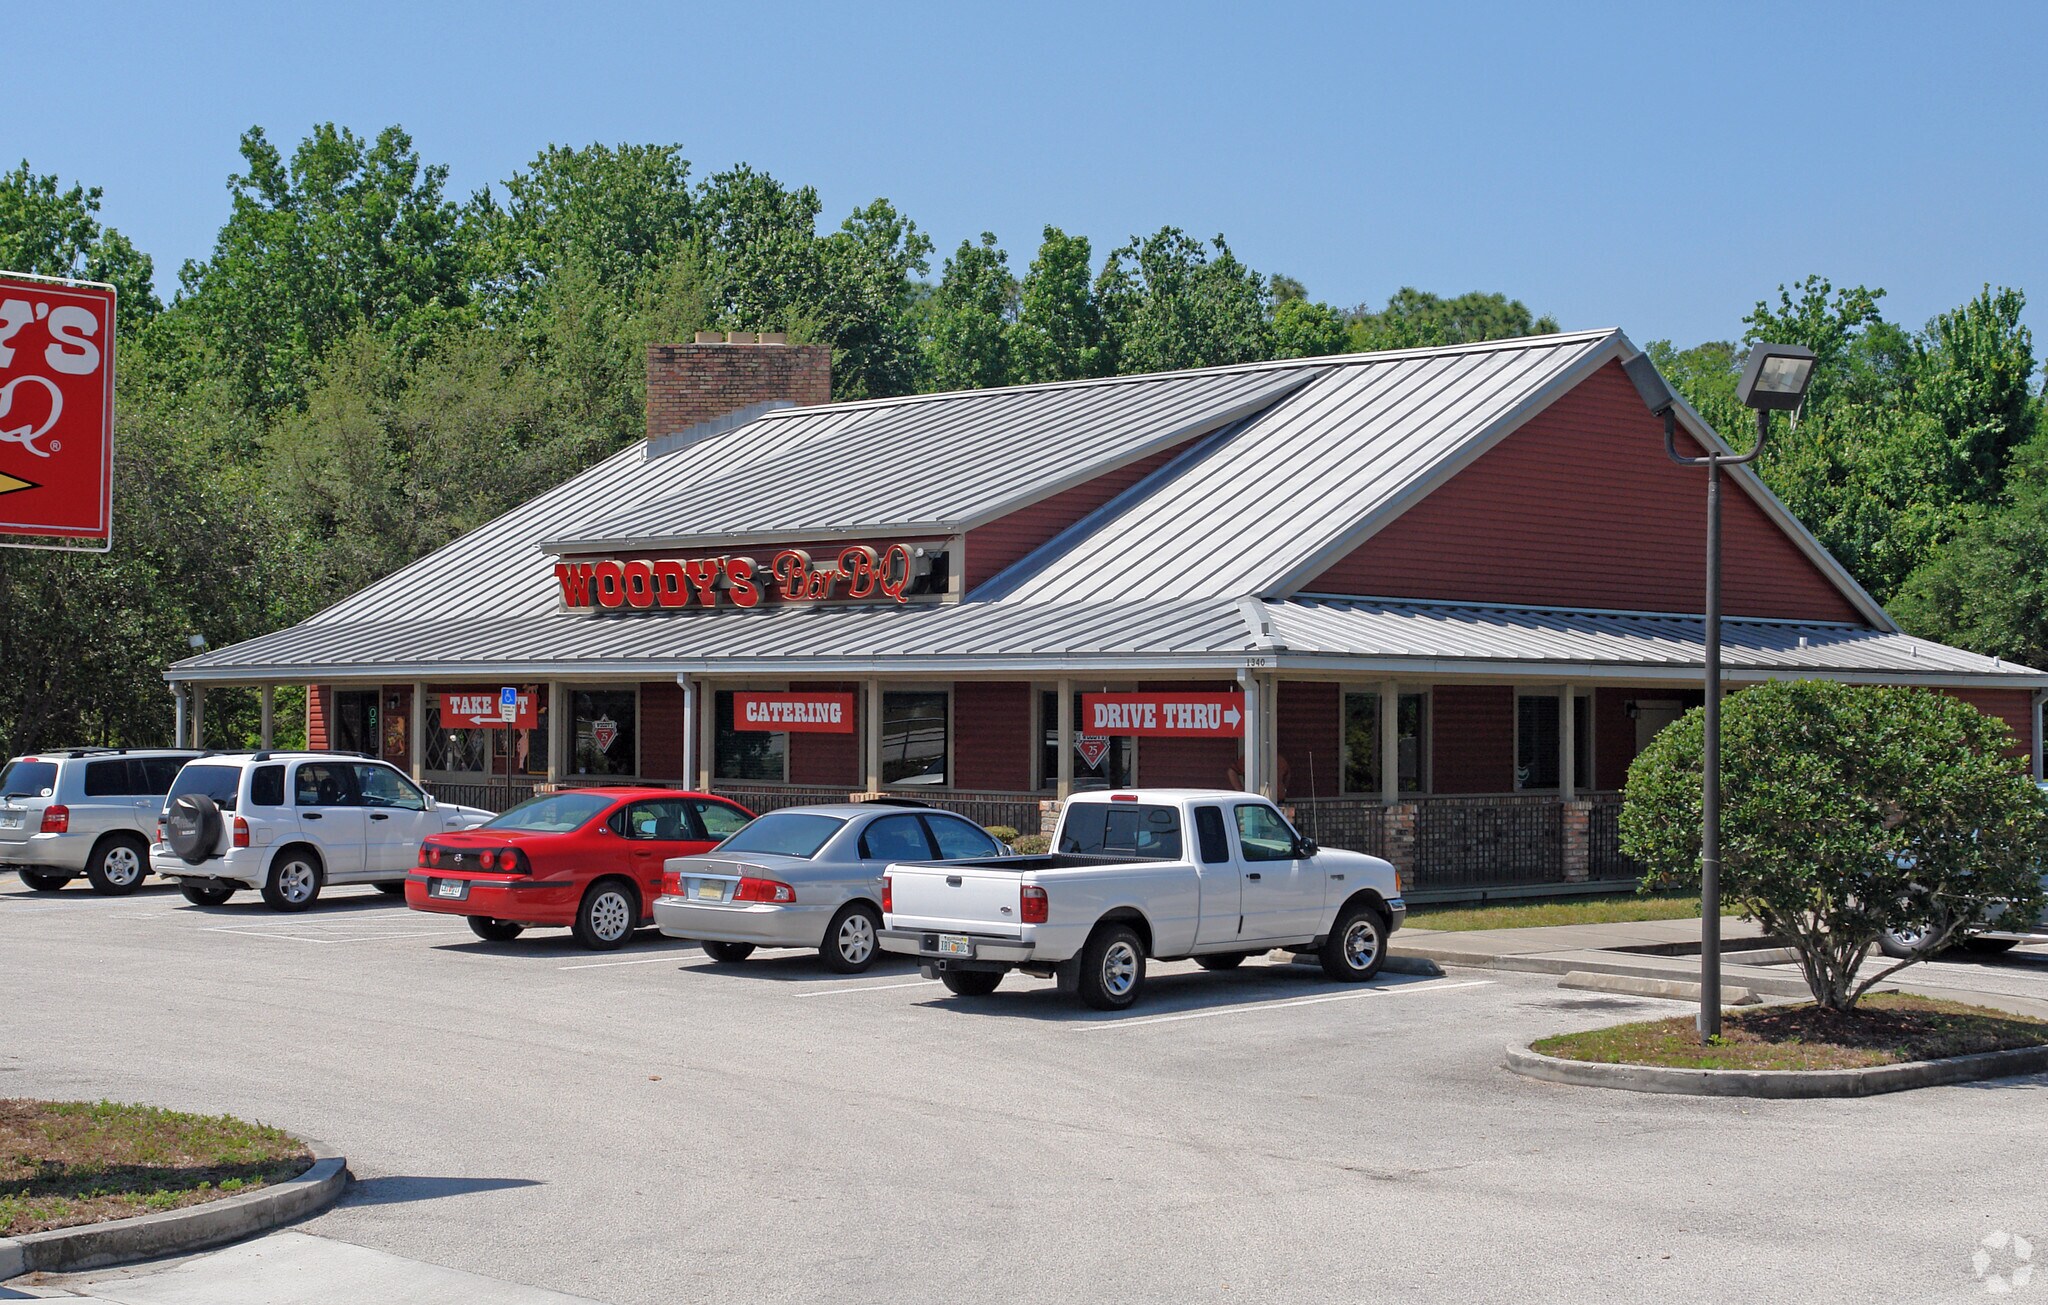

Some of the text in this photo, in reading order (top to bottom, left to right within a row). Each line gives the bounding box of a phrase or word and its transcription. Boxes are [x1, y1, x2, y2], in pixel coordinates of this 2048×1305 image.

[554, 557, 760, 608] WOODY'S
[449, 696, 492, 714] TAKE
[746, 702, 842, 723] CATERING
[1093, 703, 1221, 730] DRIVE THRU
[1087, 745, 1098, 756] 25
